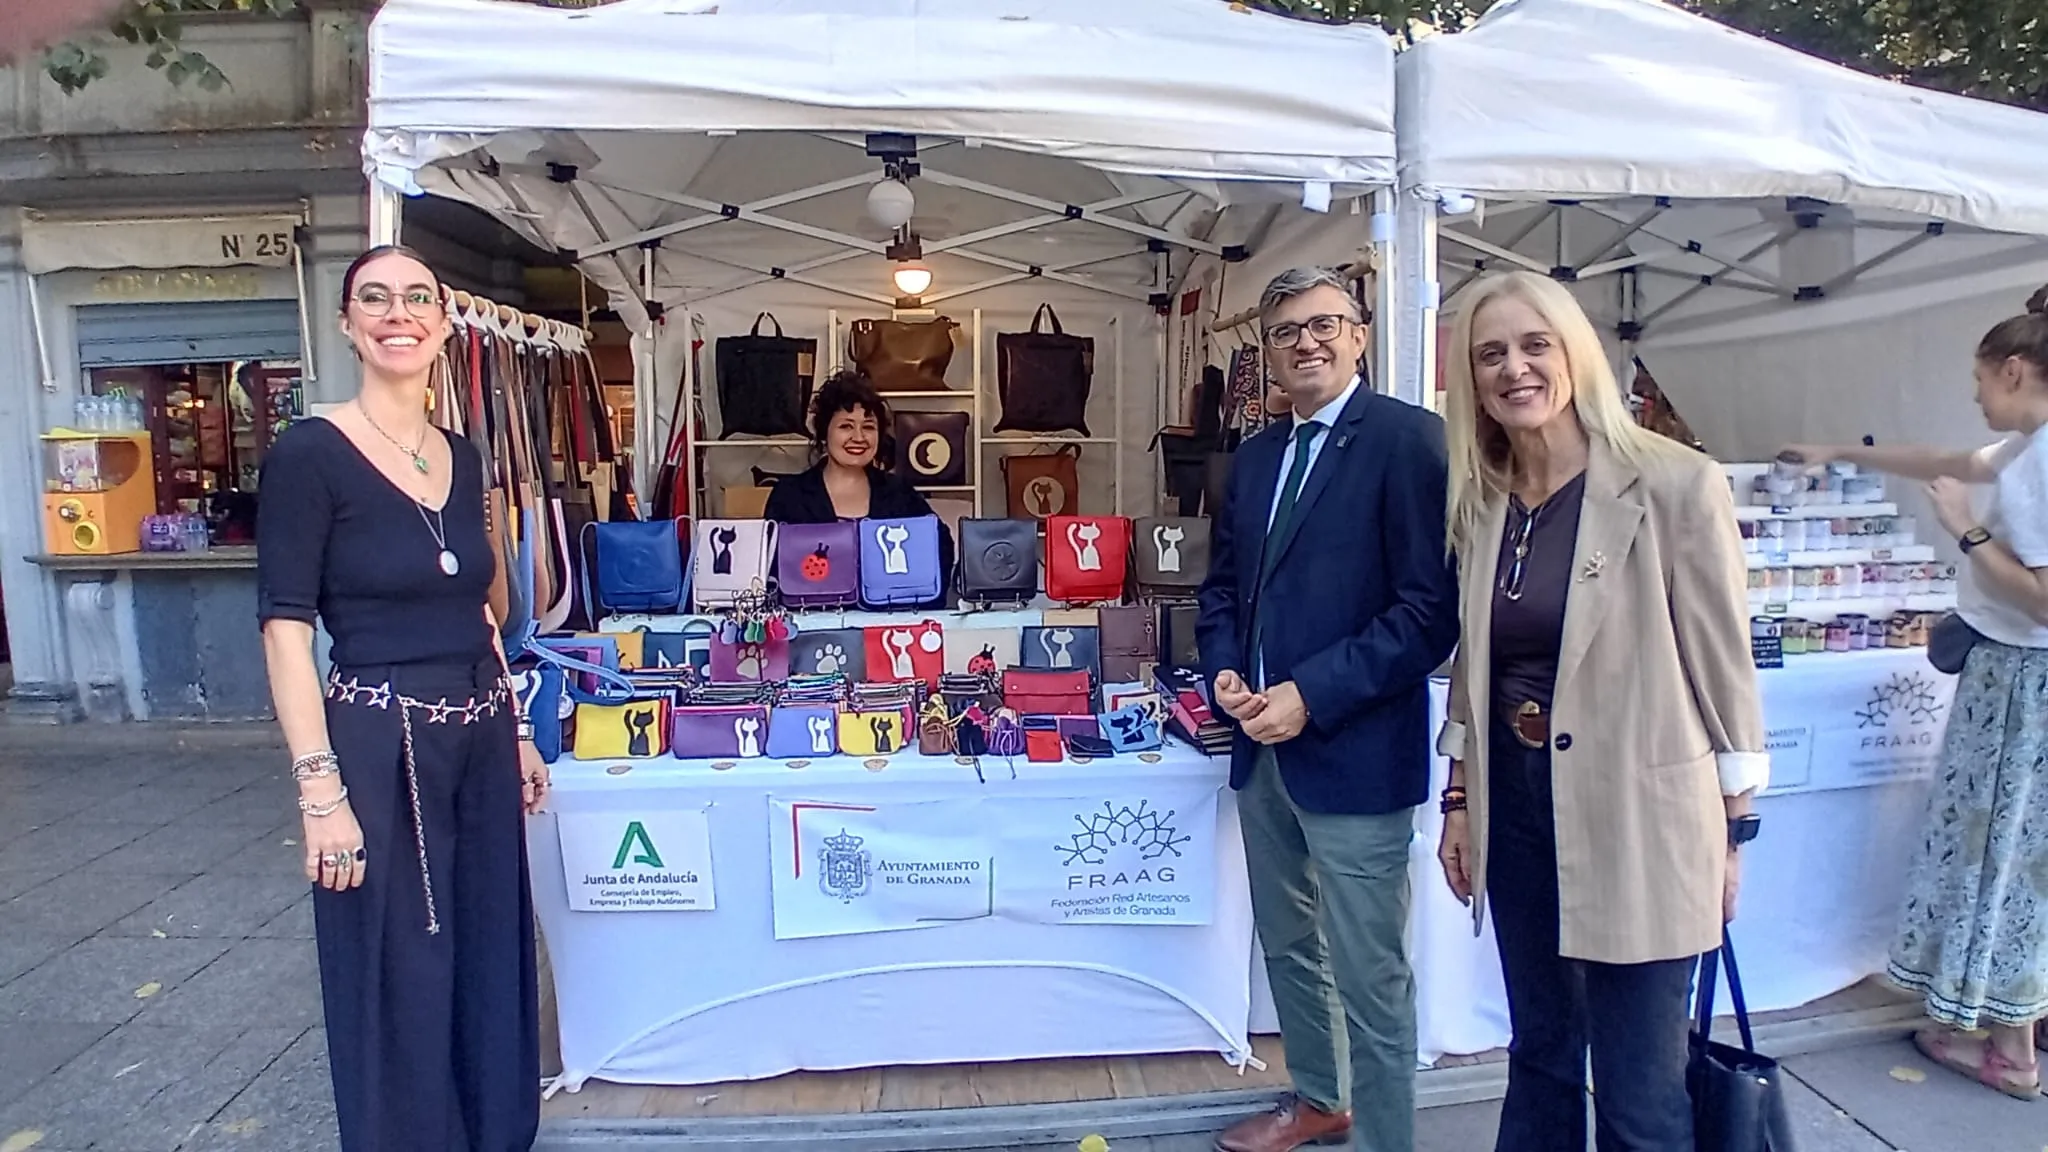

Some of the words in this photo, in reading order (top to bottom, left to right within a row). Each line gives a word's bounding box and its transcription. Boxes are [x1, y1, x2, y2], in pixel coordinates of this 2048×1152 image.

[256, 232, 288, 257] 25
[877, 859, 980, 872] AYUNTAMIENTO
[582, 874, 617, 885] Junta
[619, 873, 635, 884] de
[637, 871, 698, 884] Andalucía
[907, 872, 971, 885] GRANADA
[1068, 867, 1175, 891] FRAAG
[641, 888, 650, 897] de
[1051, 895, 1110, 908] Federación
[1112, 893, 1134, 903] Red
[1136, 892, 1191, 903] Artesanos
[1064, 909, 1071, 918] y
[1072, 907, 1111, 916] Artistas
[1113, 905, 1127, 915] de
[1129, 904, 1176, 916] Granada
